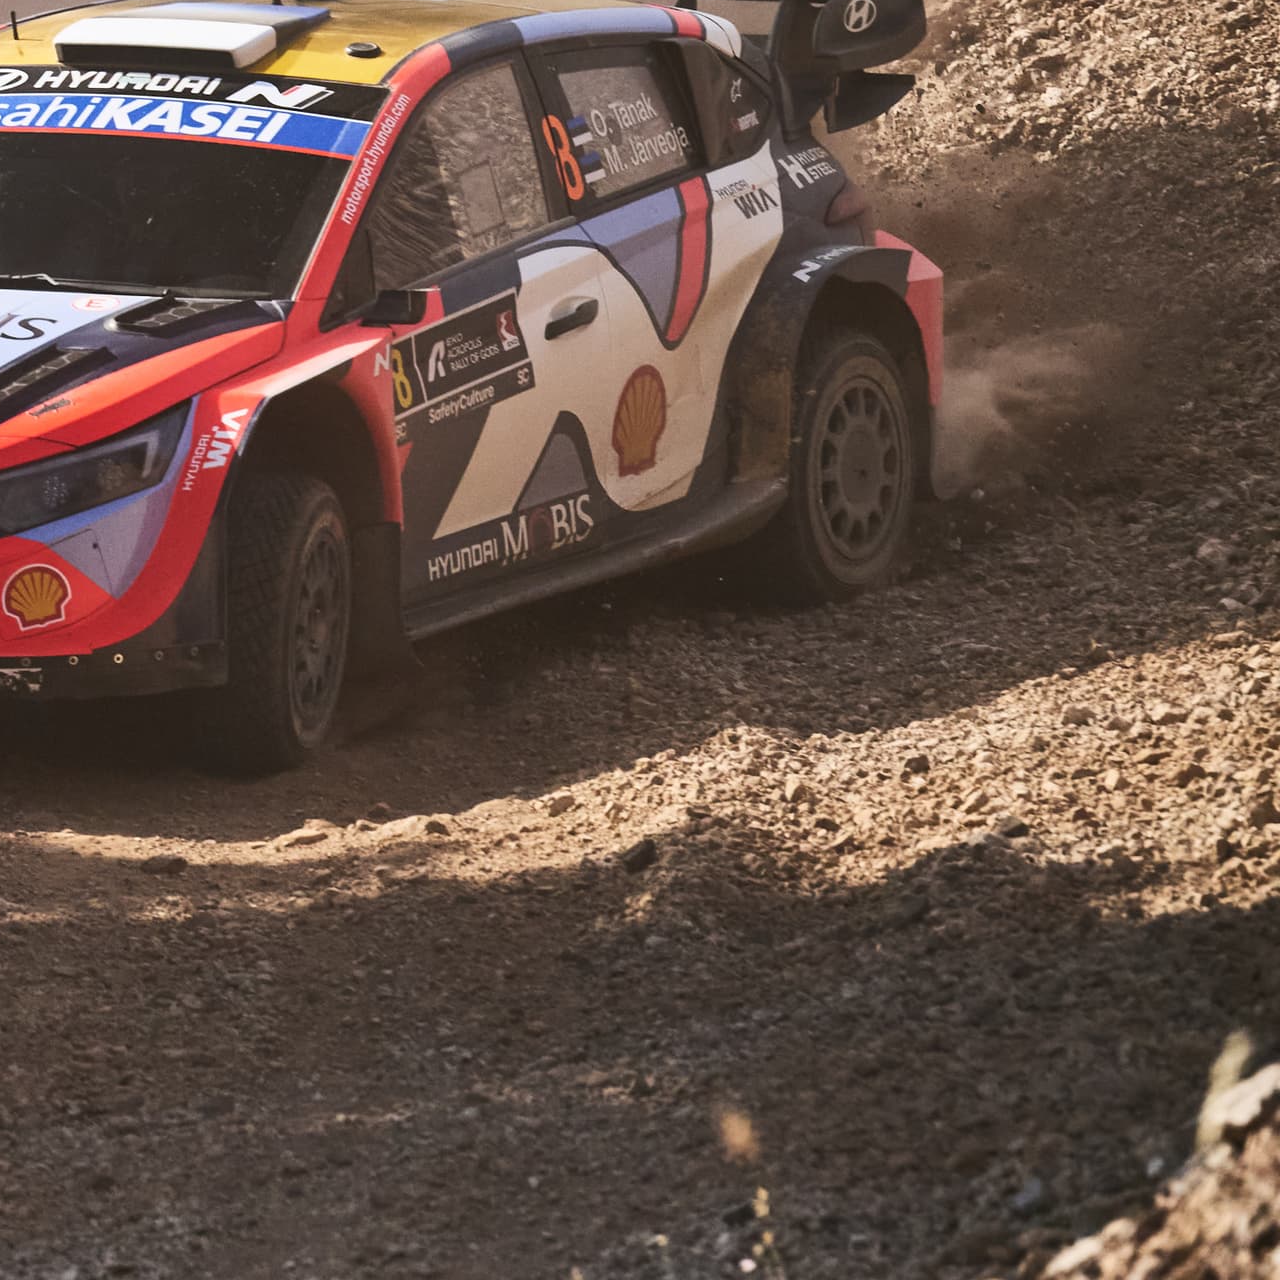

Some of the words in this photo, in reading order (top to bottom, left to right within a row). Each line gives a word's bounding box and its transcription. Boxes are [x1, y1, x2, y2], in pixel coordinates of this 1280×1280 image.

[33, 70, 223, 96] HYUNDAI
[590, 108, 614, 137] O.
[604, 144, 628, 175] M.
[629, 122, 689, 166] Järveoja
[341, 93, 411, 225] motorsport.hyundai.com
[541, 114, 585, 201] 8
[733, 184, 779, 220] WIA
[428, 384, 496, 425] SafetyCulture
[181, 433, 212, 492] HYUNDAI
[201, 407, 250, 470] WIA
[427, 537, 500, 582] HYUNDAI
[500, 493, 595, 567] MOBIS
